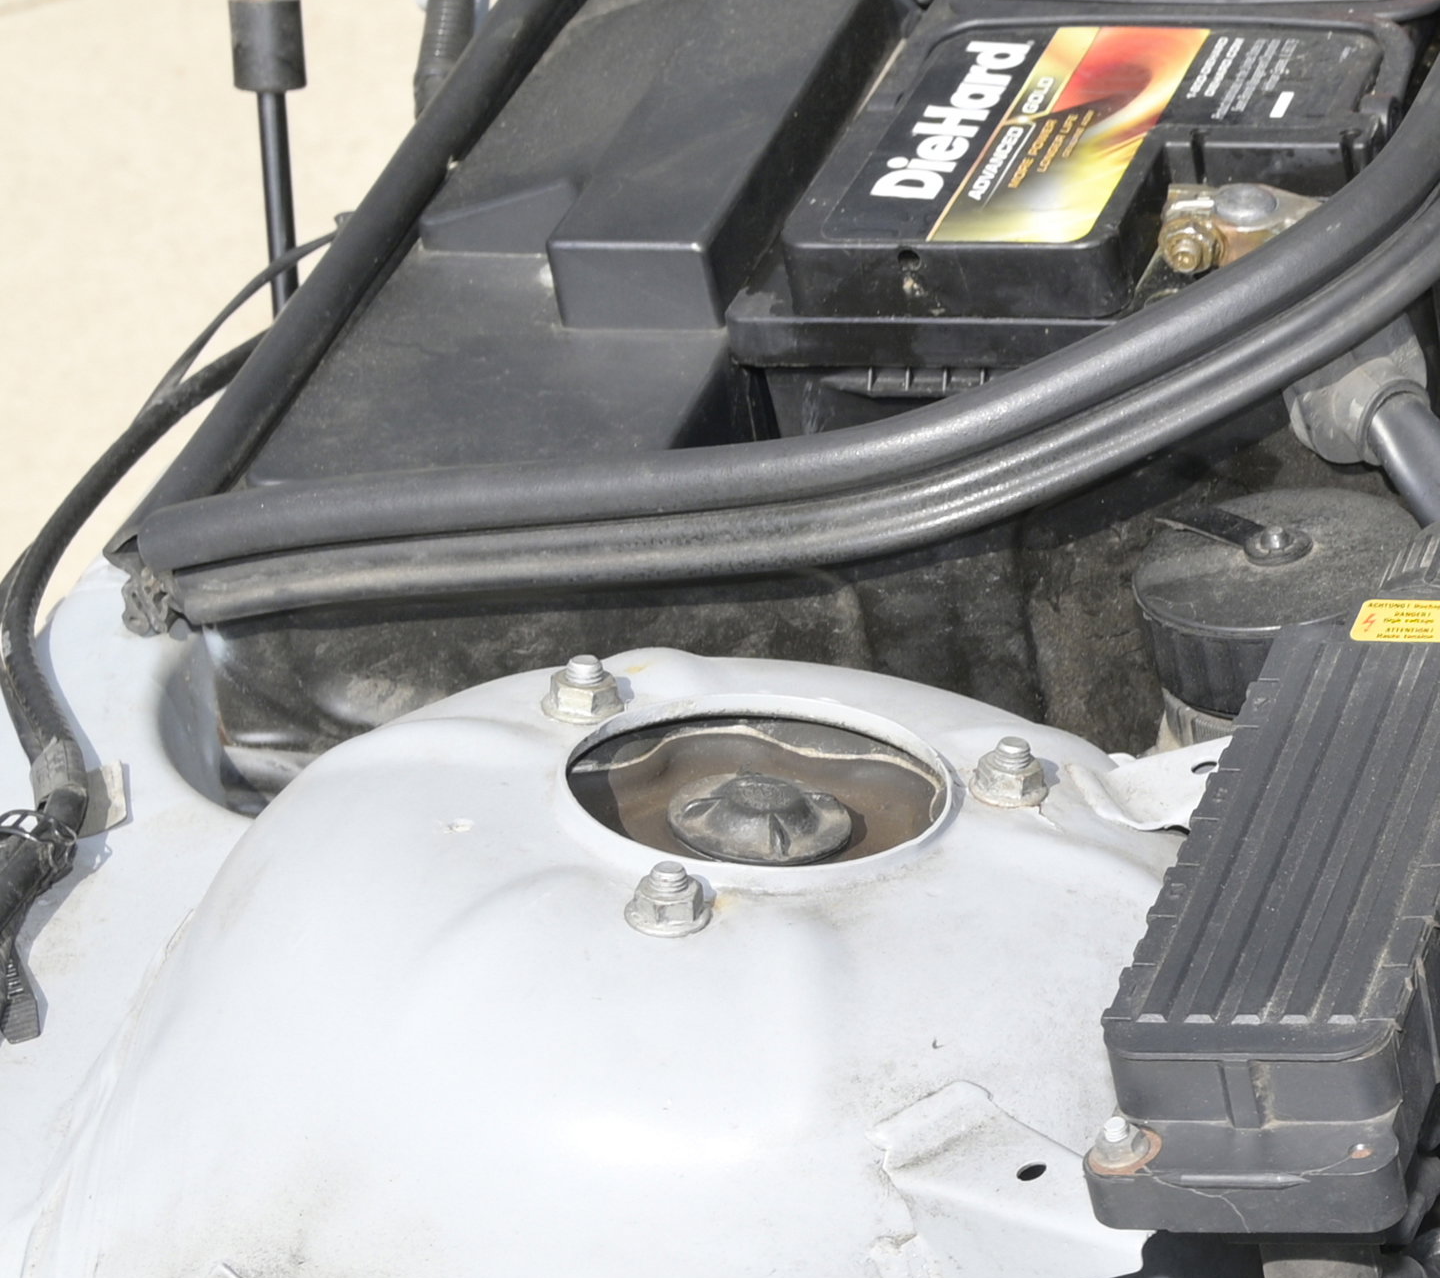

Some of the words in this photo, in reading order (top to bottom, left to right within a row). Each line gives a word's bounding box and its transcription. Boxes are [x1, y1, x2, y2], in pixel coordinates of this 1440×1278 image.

[870, 41, 1028, 200] DieHard
[968, 127, 1024, 201] ADVANCED
[1022, 77, 1055, 114] GOLD
[1008, 156, 1032, 189] MORE
[1027, 119, 1058, 159] POWER
